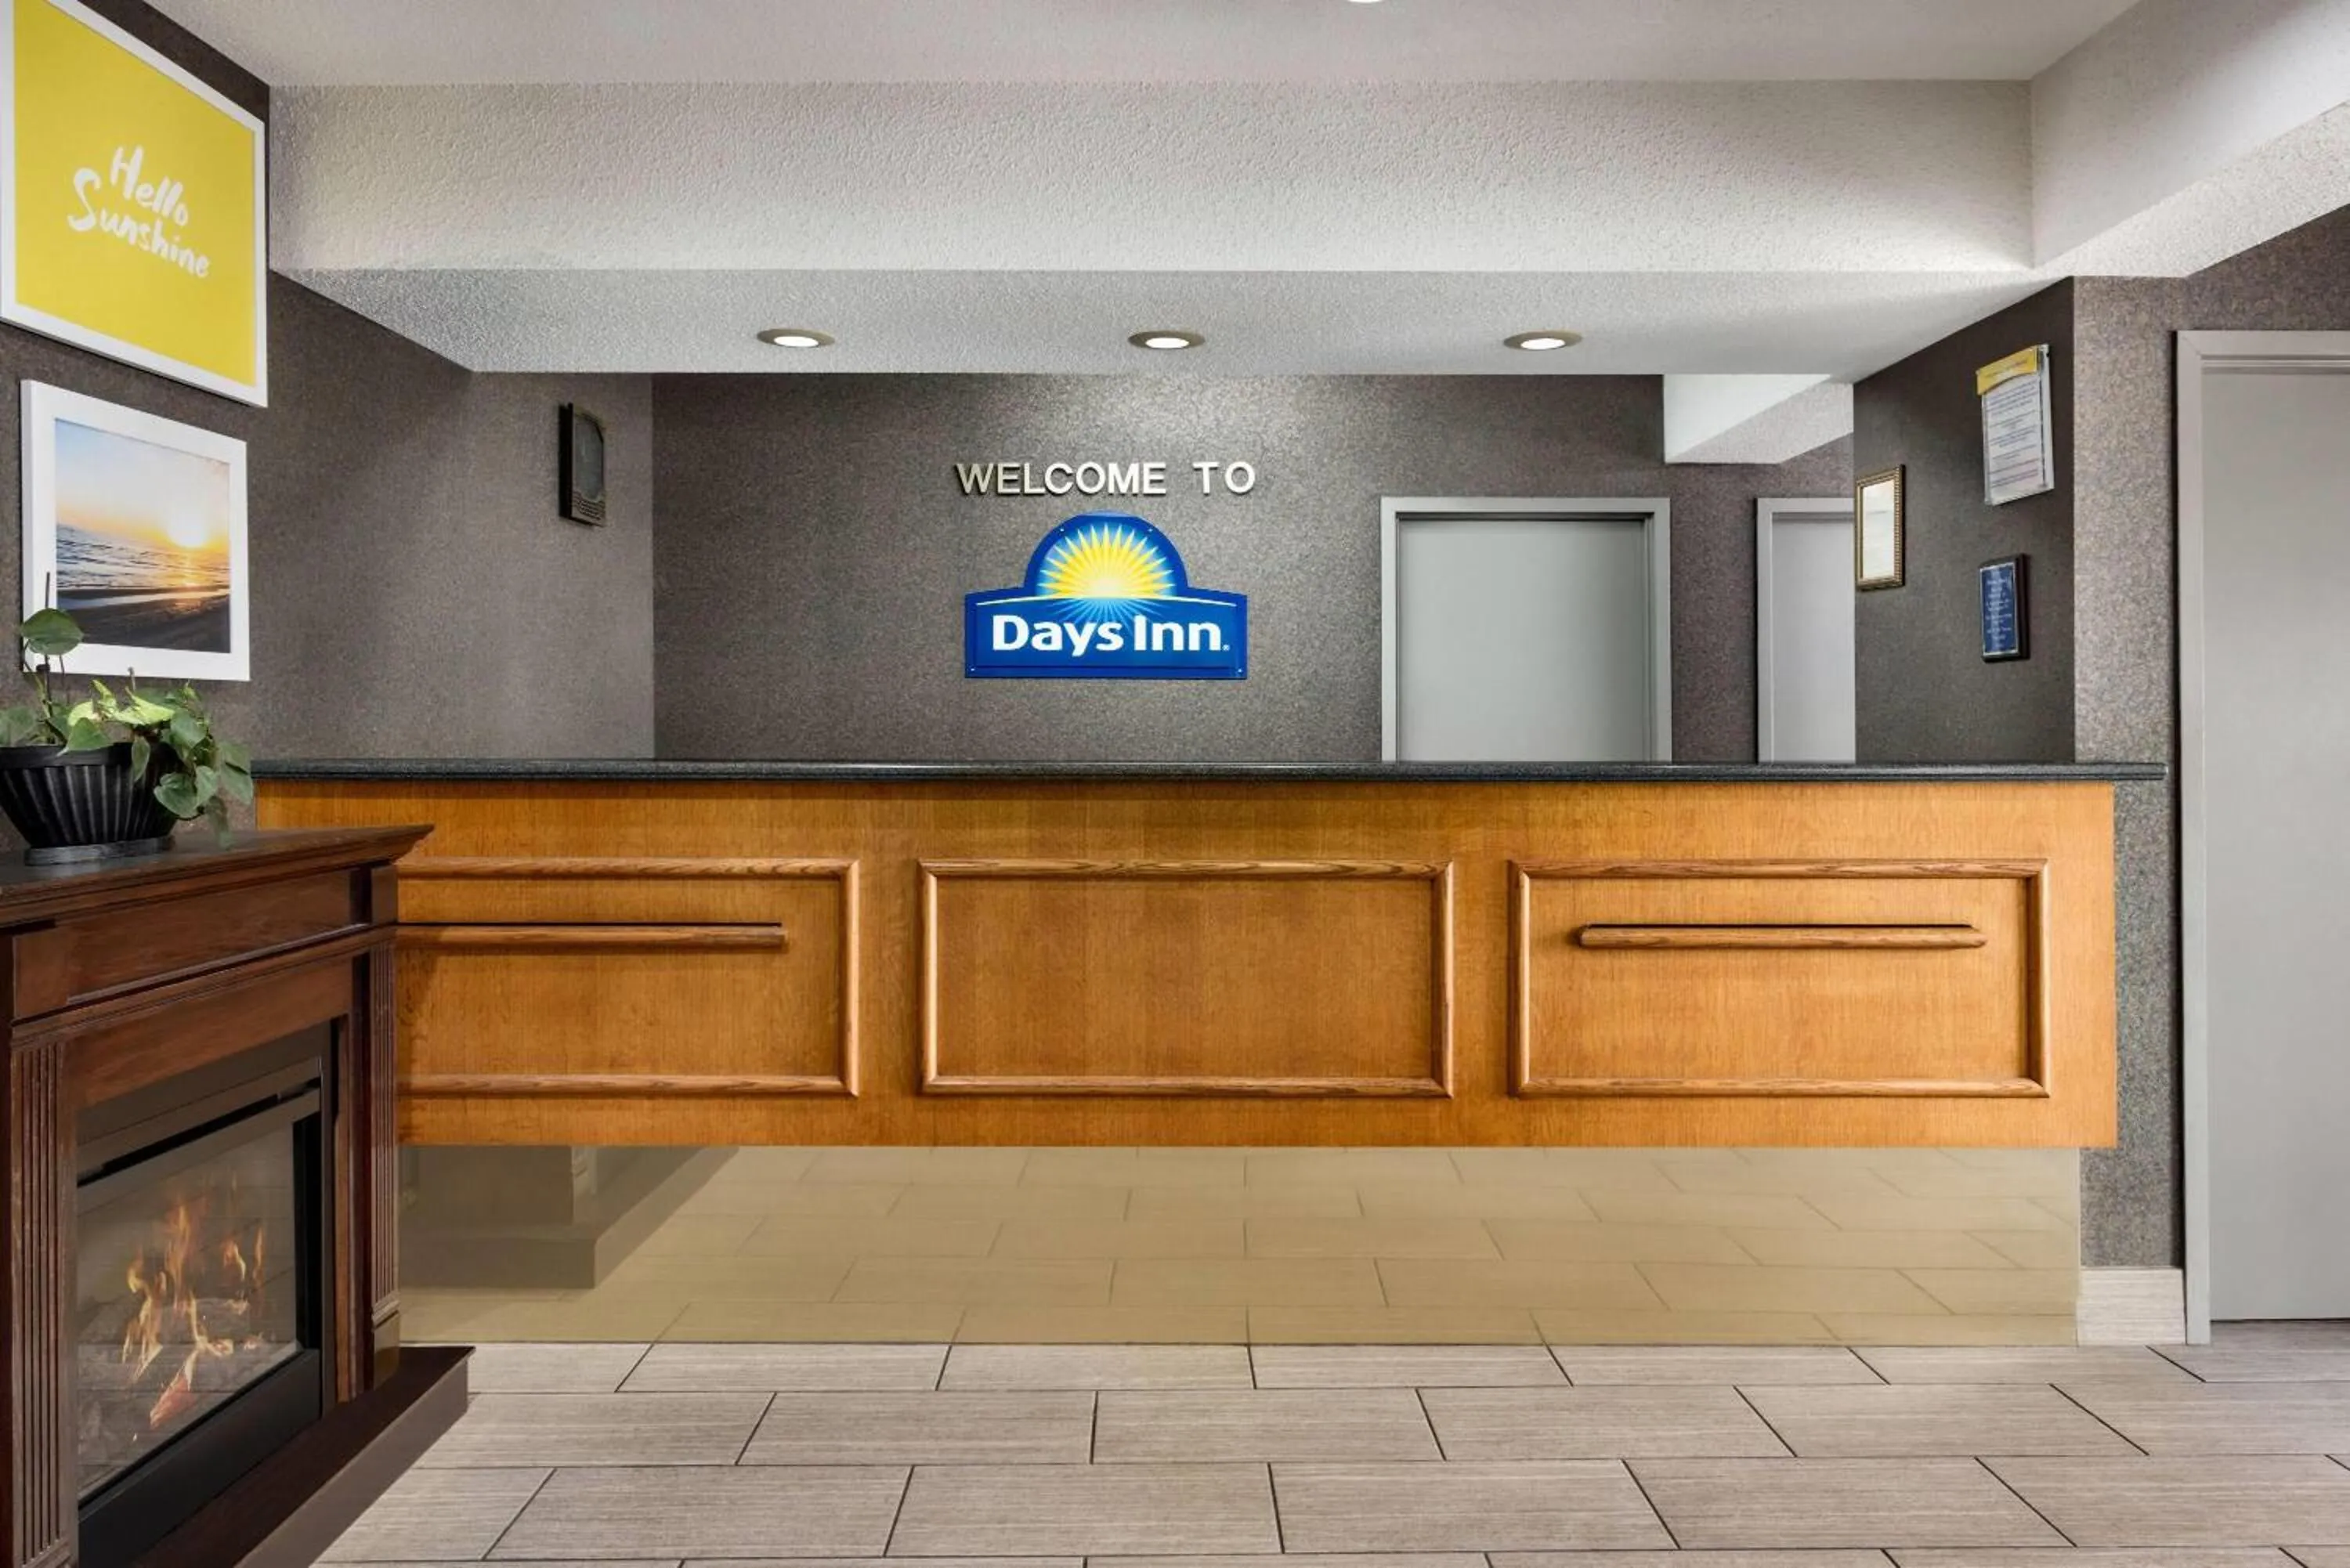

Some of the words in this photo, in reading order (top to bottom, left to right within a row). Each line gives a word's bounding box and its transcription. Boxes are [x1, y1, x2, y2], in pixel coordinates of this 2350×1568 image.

[110, 145, 189, 227] Hello
[67, 167, 211, 278] Sunshine
[956, 461, 1166, 495] WELCOME
[1192, 461, 1256, 495] TO
[992, 614, 1124, 657] Days
[1133, 614, 1221, 652] Inn
